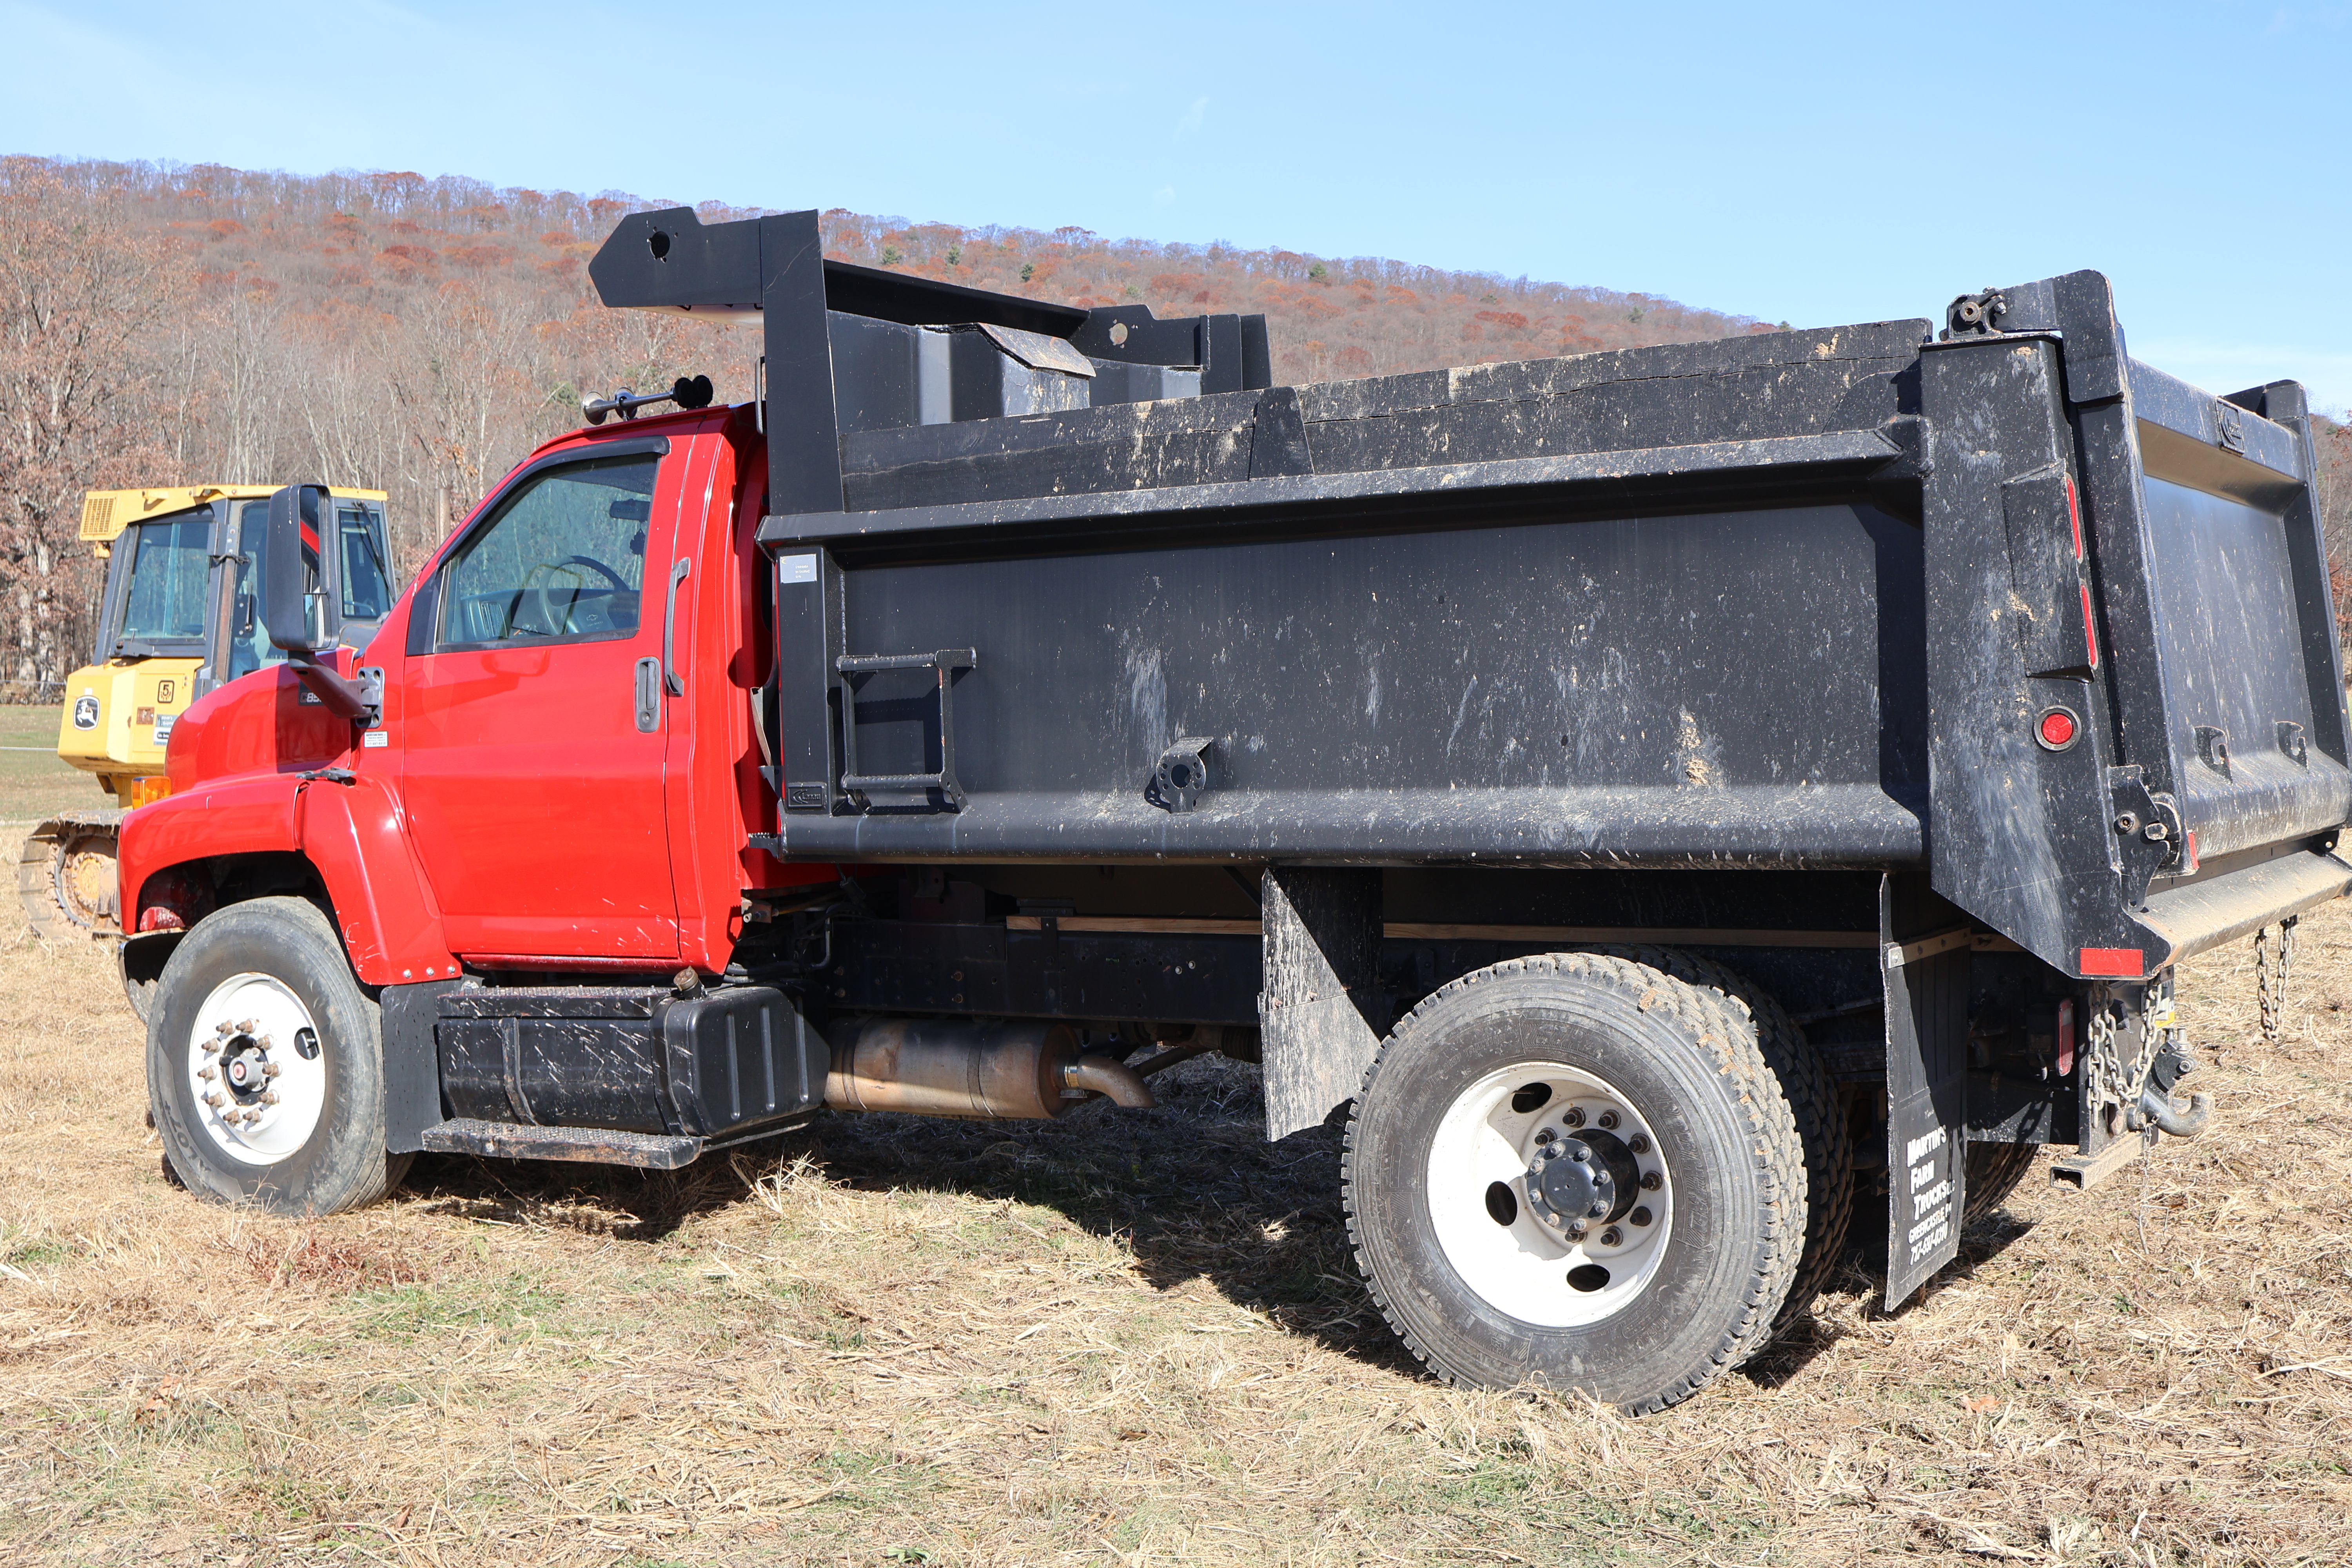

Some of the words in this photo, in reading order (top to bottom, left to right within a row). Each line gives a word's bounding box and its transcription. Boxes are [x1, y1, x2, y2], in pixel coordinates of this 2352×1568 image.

[300, 692, 322, 703] C85
[1907, 1124, 1947, 1167] MARTIN'S
[1910, 1160, 1935, 1195] FARM
[1914, 1180, 1947, 1220] TRUCKS
[1947, 1179, 1956, 1195] LLC
[1910, 1221, 1948, 1265] 717-597-0310
